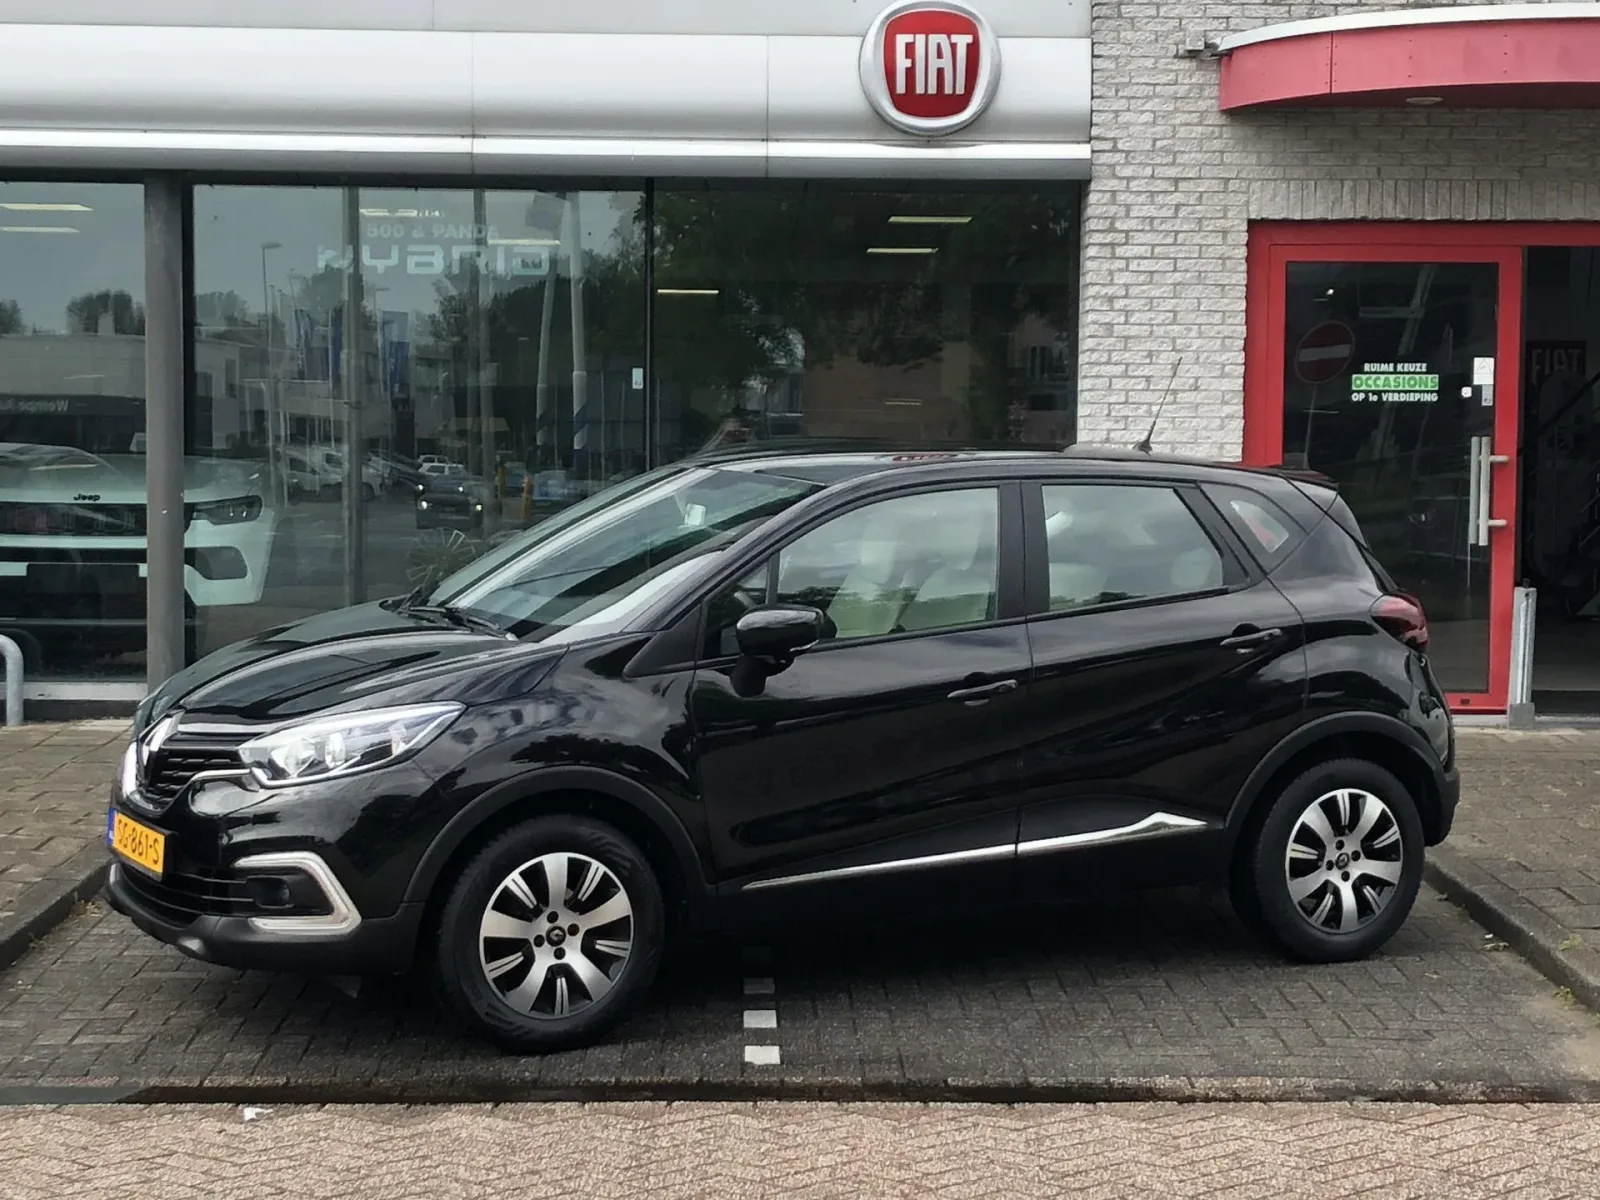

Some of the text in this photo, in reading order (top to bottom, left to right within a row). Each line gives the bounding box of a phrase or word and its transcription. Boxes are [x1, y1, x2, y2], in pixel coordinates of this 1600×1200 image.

[895, 34, 974, 94] FIAT
[366, 224, 500, 239] 500 & PANDA
[1363, 363, 1427, 372] RUIME KEUZE
[1531, 349, 1583, 385] FIAT
[1353, 375, 1438, 389] OCCASIONS
[1351, 392, 1366, 402] OP
[1381, 392, 1439, 402] VERDIEPING
[73, 493, 101, 502] Jeep
